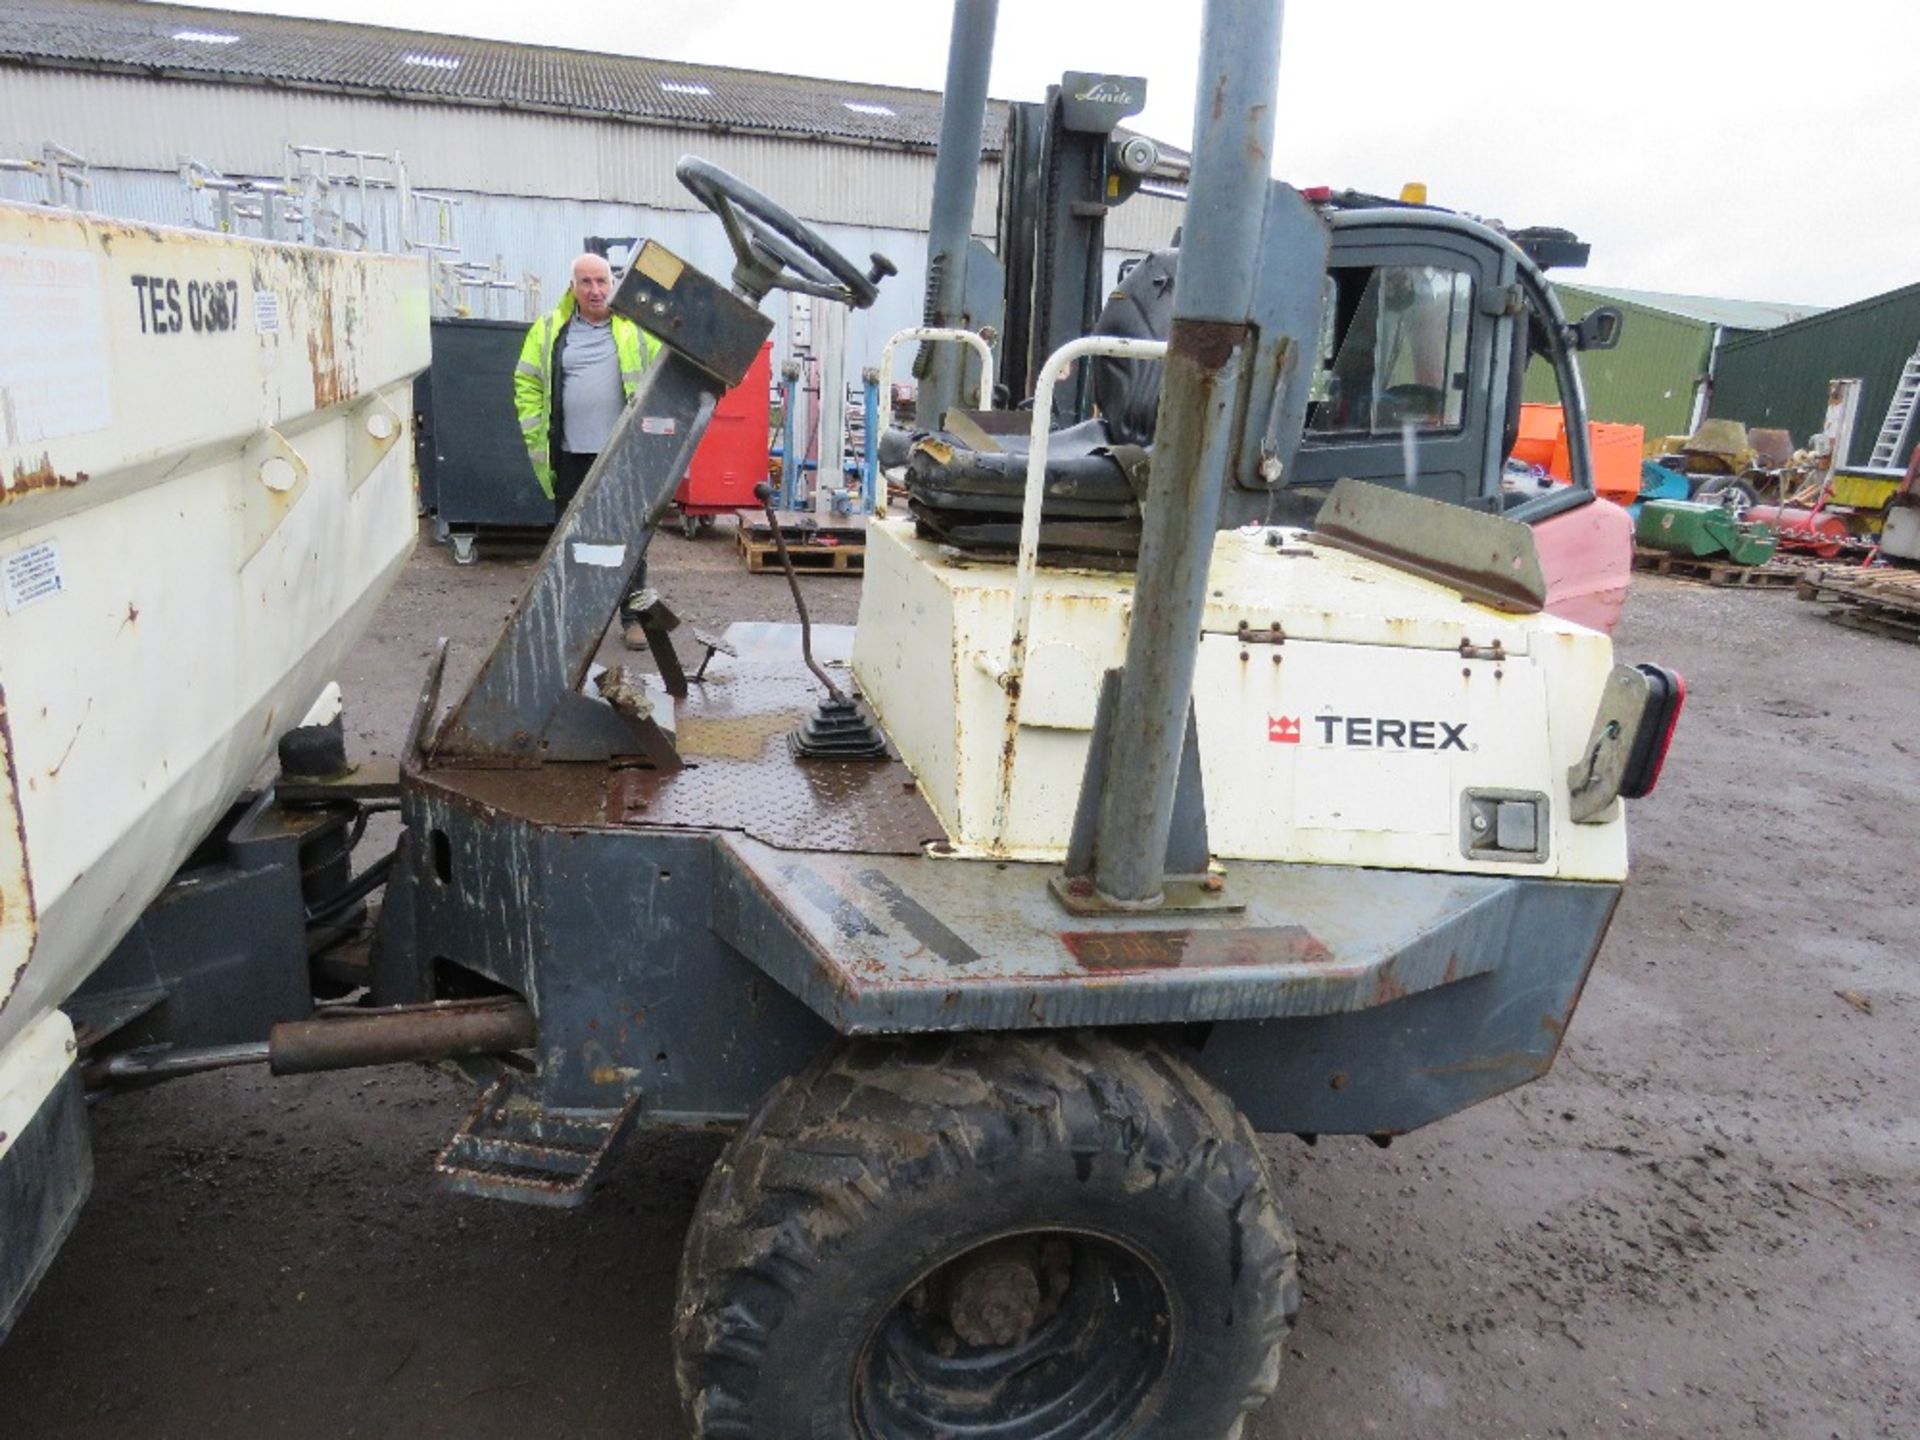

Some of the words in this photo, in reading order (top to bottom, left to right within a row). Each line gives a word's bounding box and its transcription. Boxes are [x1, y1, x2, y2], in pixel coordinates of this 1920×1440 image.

[1074, 82, 1132, 104] Linde
[131, 274, 183, 334] TES
[1314, 715, 1469, 751] TEREX
